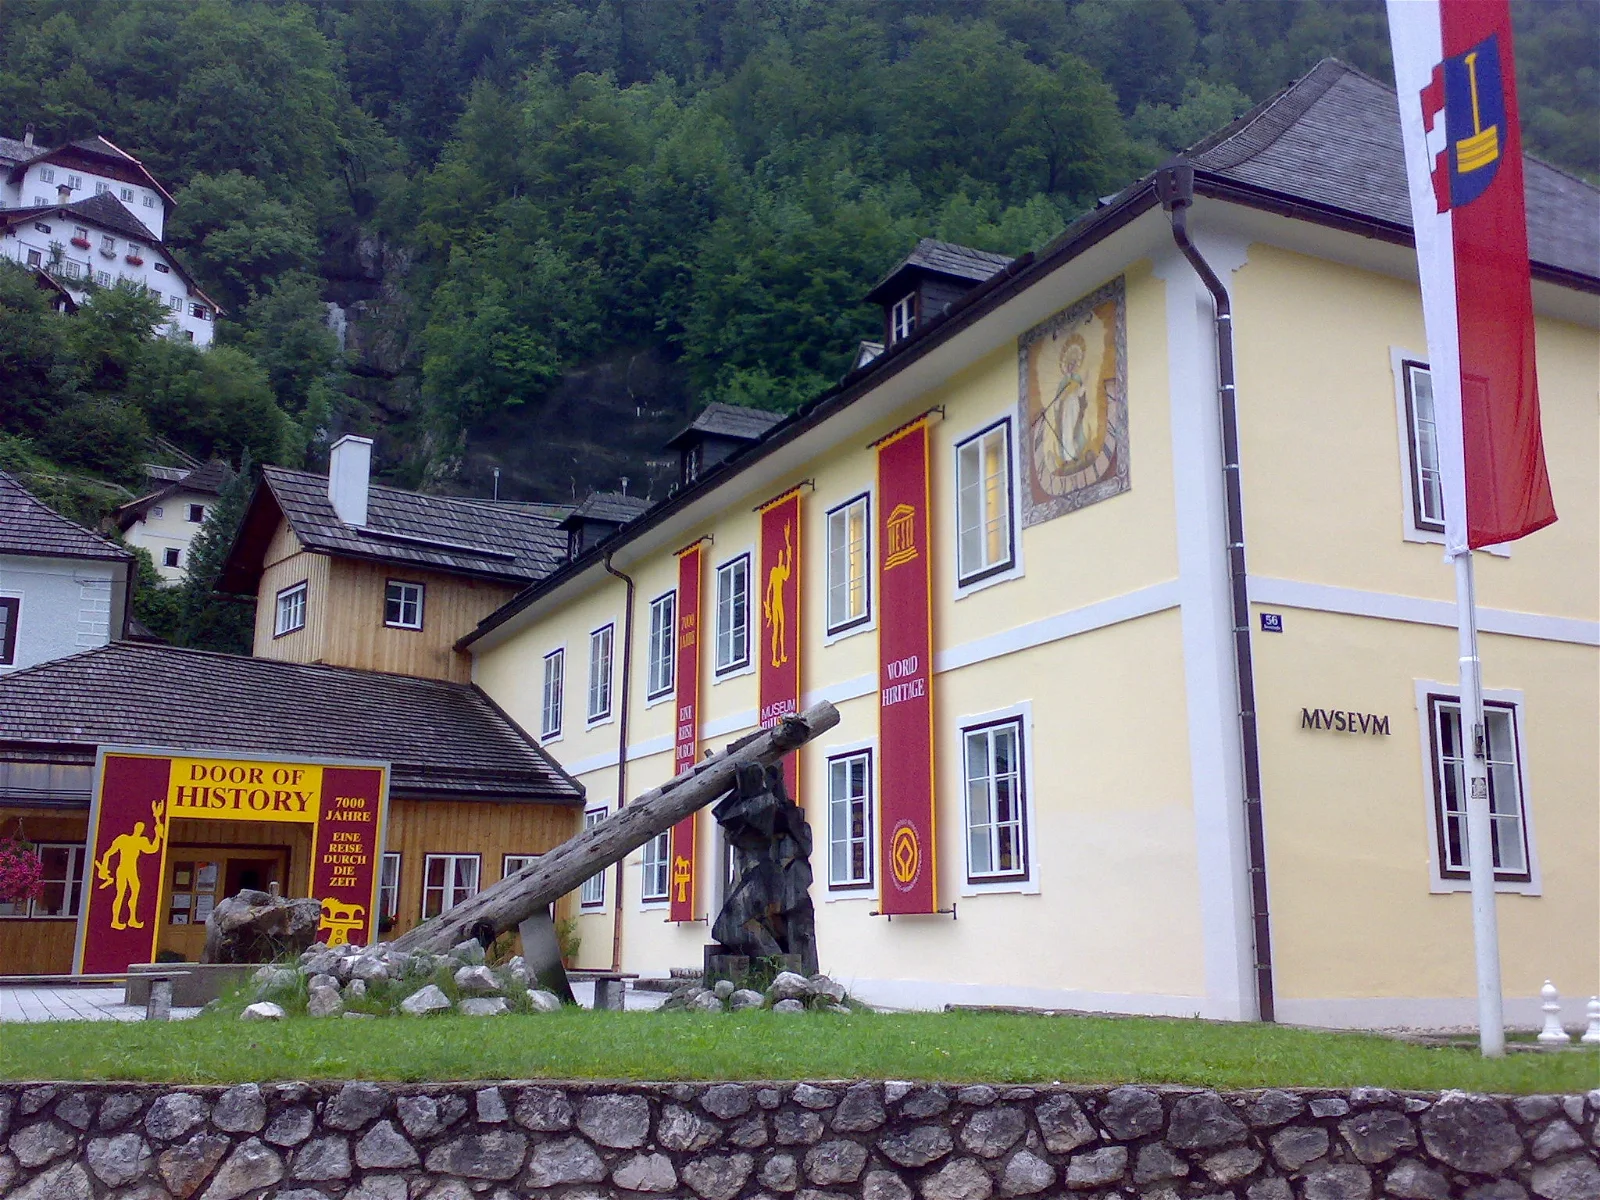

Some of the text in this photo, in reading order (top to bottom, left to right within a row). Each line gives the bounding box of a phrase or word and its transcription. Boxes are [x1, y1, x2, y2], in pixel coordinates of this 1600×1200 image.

[1265, 614, 1278, 626] 56
[761, 698, 796, 721] MUSEUM
[1301, 707, 1392, 736] MVSEVM
[189, 763, 306, 786] DOOR OF
[174, 785, 315, 813] HISTORY
[335, 796, 365, 809] 7000
[325, 809, 372, 822] JAHRE
[333, 832, 361, 843] EINE
[328, 843, 363, 854] REISE
[323, 854, 367, 865] DURCH
[333, 865, 355, 876] DIE
[328, 877, 357, 887] ZEIT
